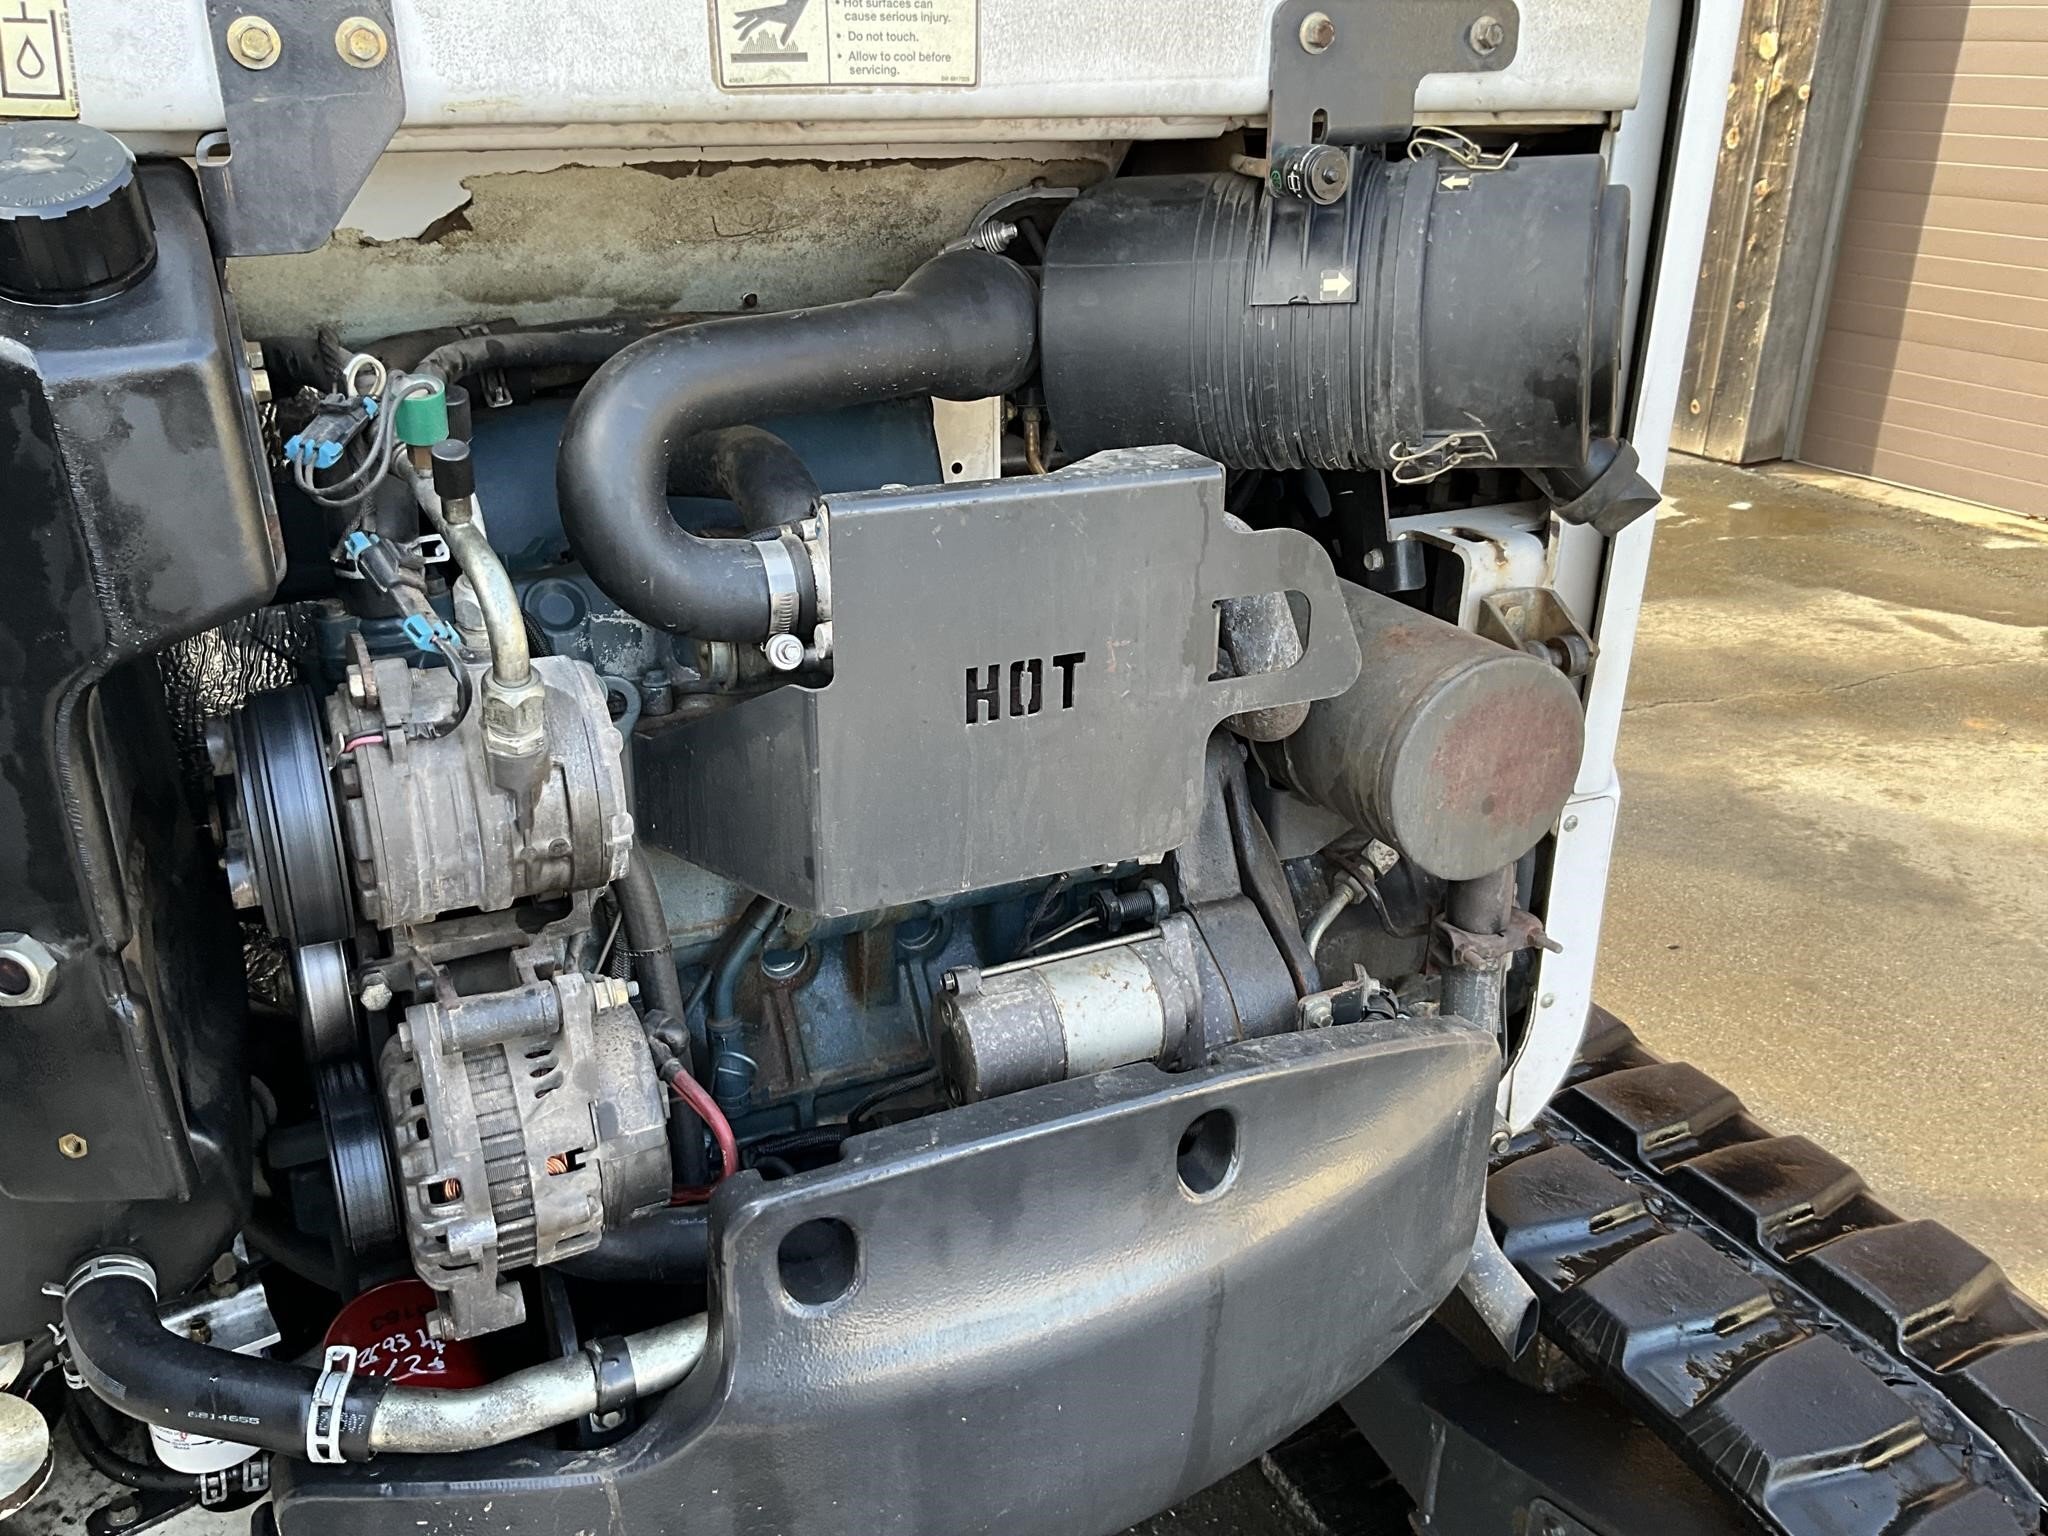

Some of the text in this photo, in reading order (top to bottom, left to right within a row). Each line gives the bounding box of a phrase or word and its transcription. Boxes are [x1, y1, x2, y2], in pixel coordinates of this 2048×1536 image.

[843, 0, 933, 9] Hot surfaces can
[844, 11, 951, 24] cause serious injury.
[848, 31, 919, 42] Do not touch.
[848, 51, 951, 62] Allow to cool before
[849, 65, 900, 77] servicing.
[965, 651, 1086, 725] HOT
